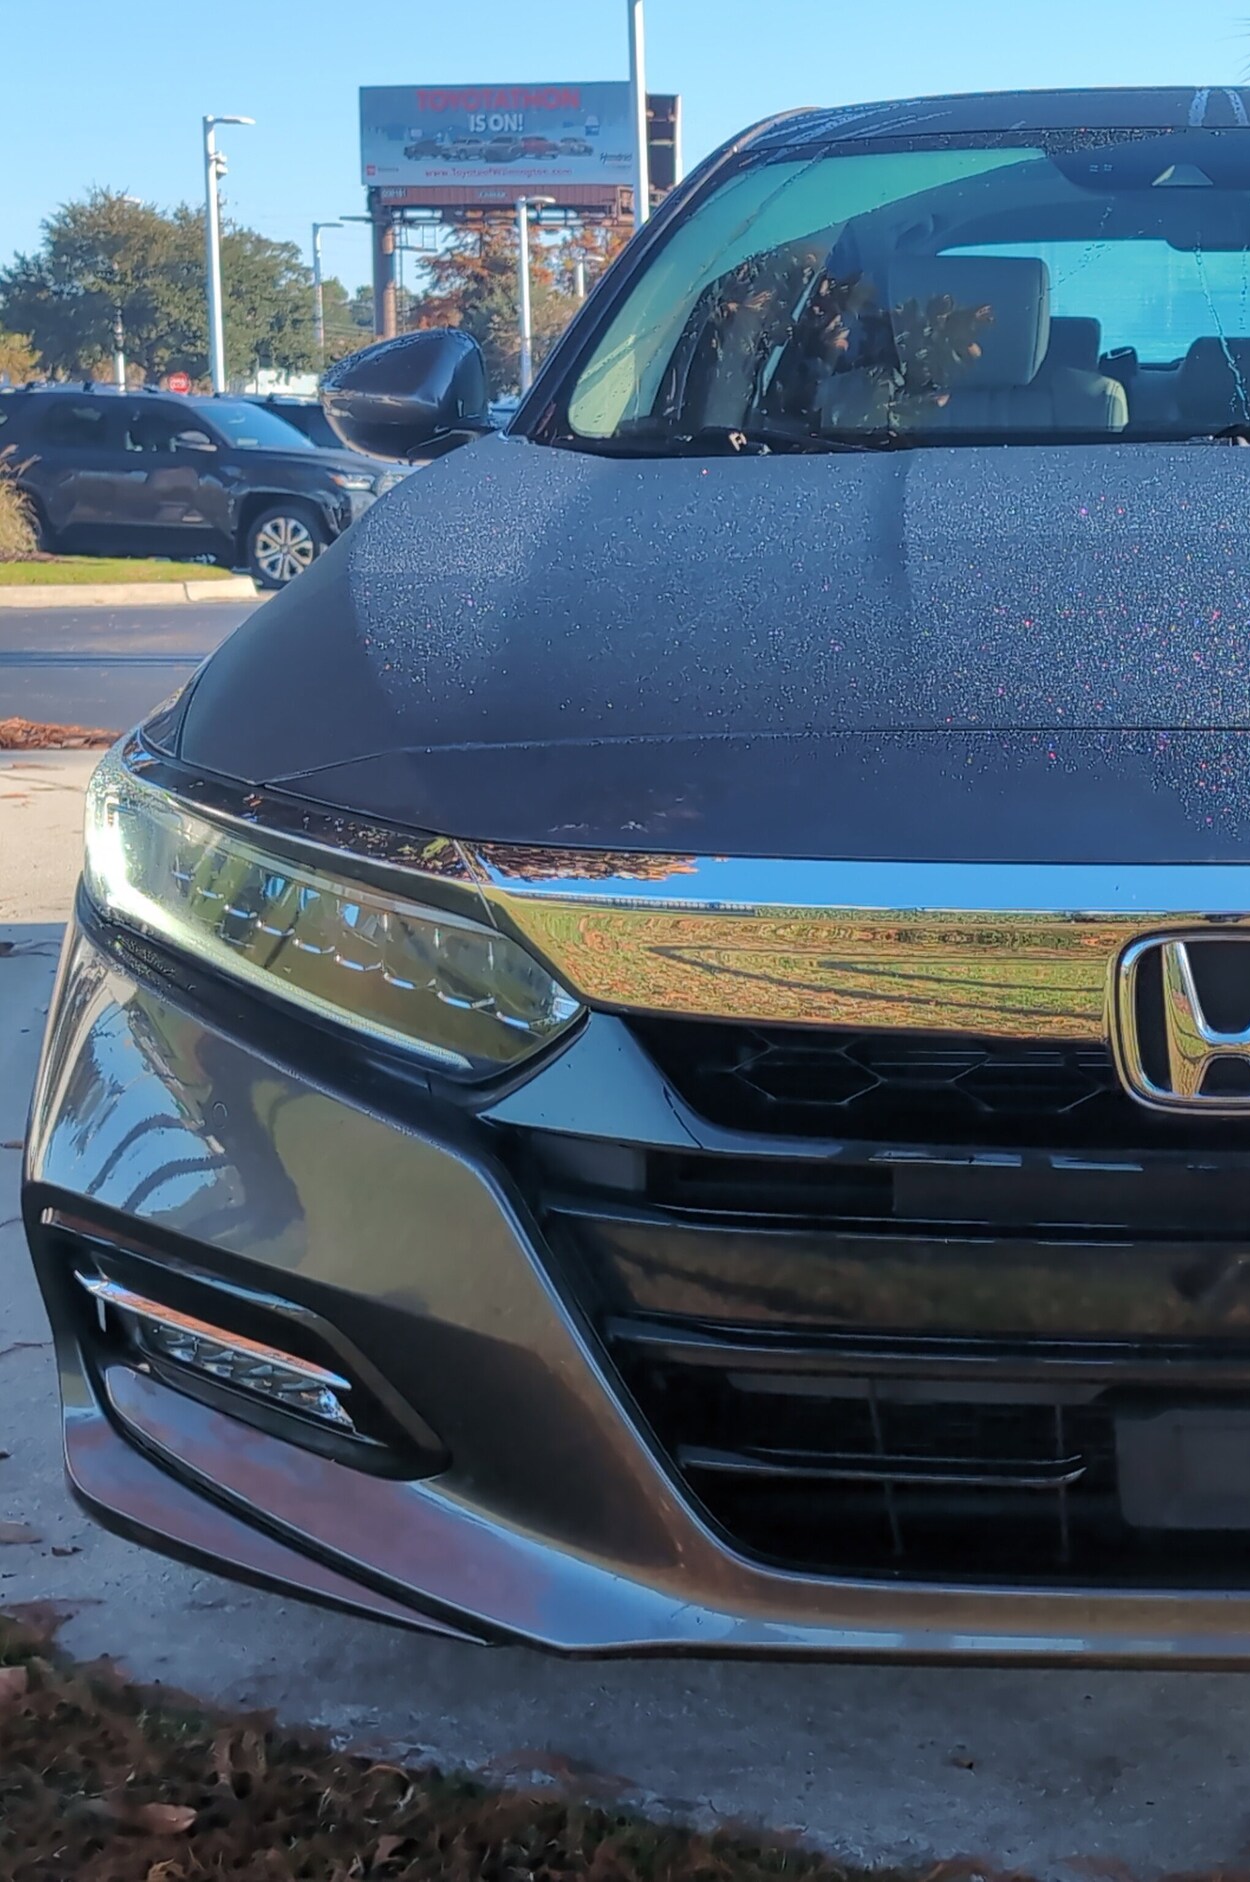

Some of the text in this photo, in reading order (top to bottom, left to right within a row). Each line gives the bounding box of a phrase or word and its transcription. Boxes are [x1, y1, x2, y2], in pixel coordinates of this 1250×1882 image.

[416, 87, 581, 112] TOYOTATHON
[469, 113, 524, 132] IS ON!
